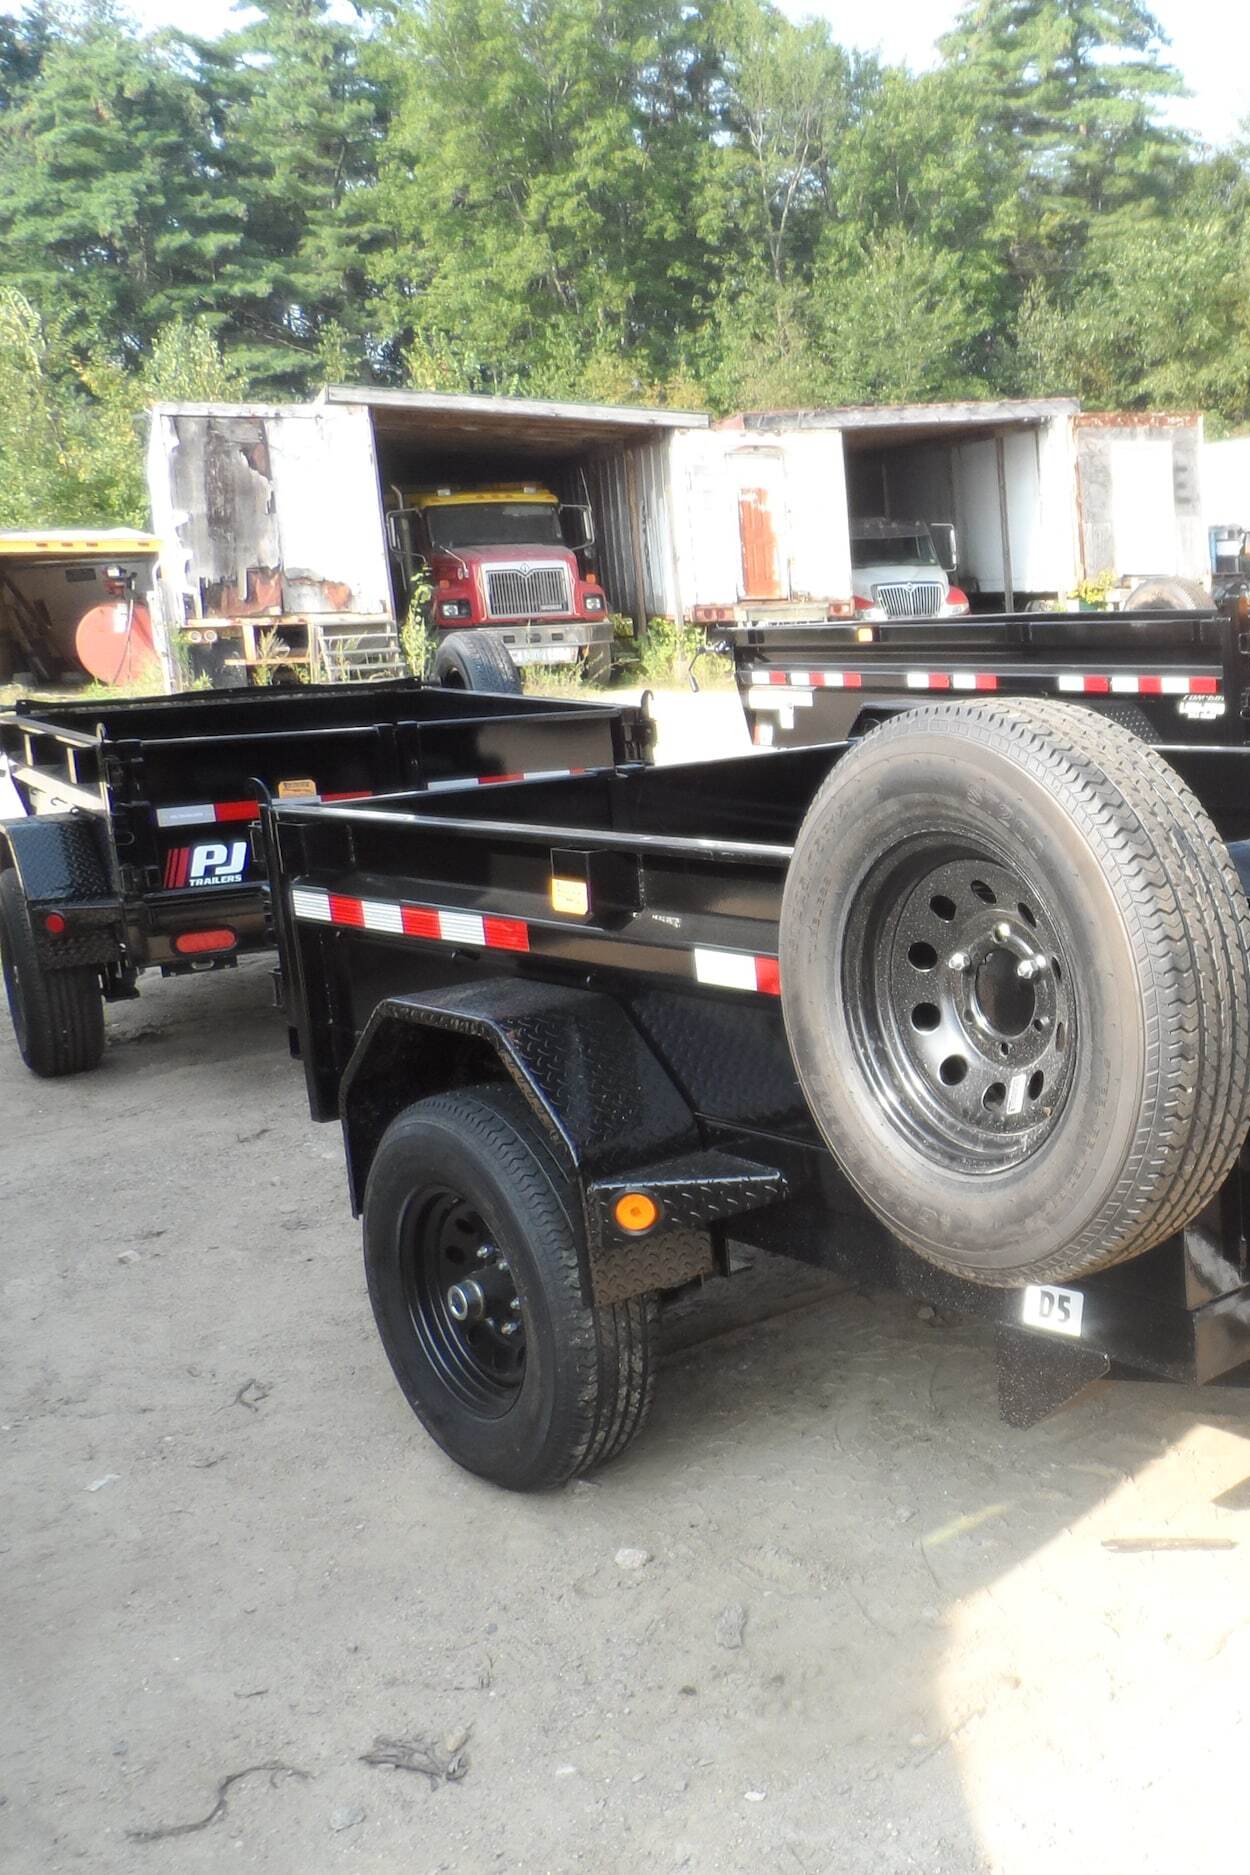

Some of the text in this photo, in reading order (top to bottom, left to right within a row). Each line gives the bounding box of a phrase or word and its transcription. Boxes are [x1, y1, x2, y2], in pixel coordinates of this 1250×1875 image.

[190, 842, 247, 878] PJ
[189, 874, 242, 887] TRAILERS
[1039, 1290, 1071, 1323] D5
